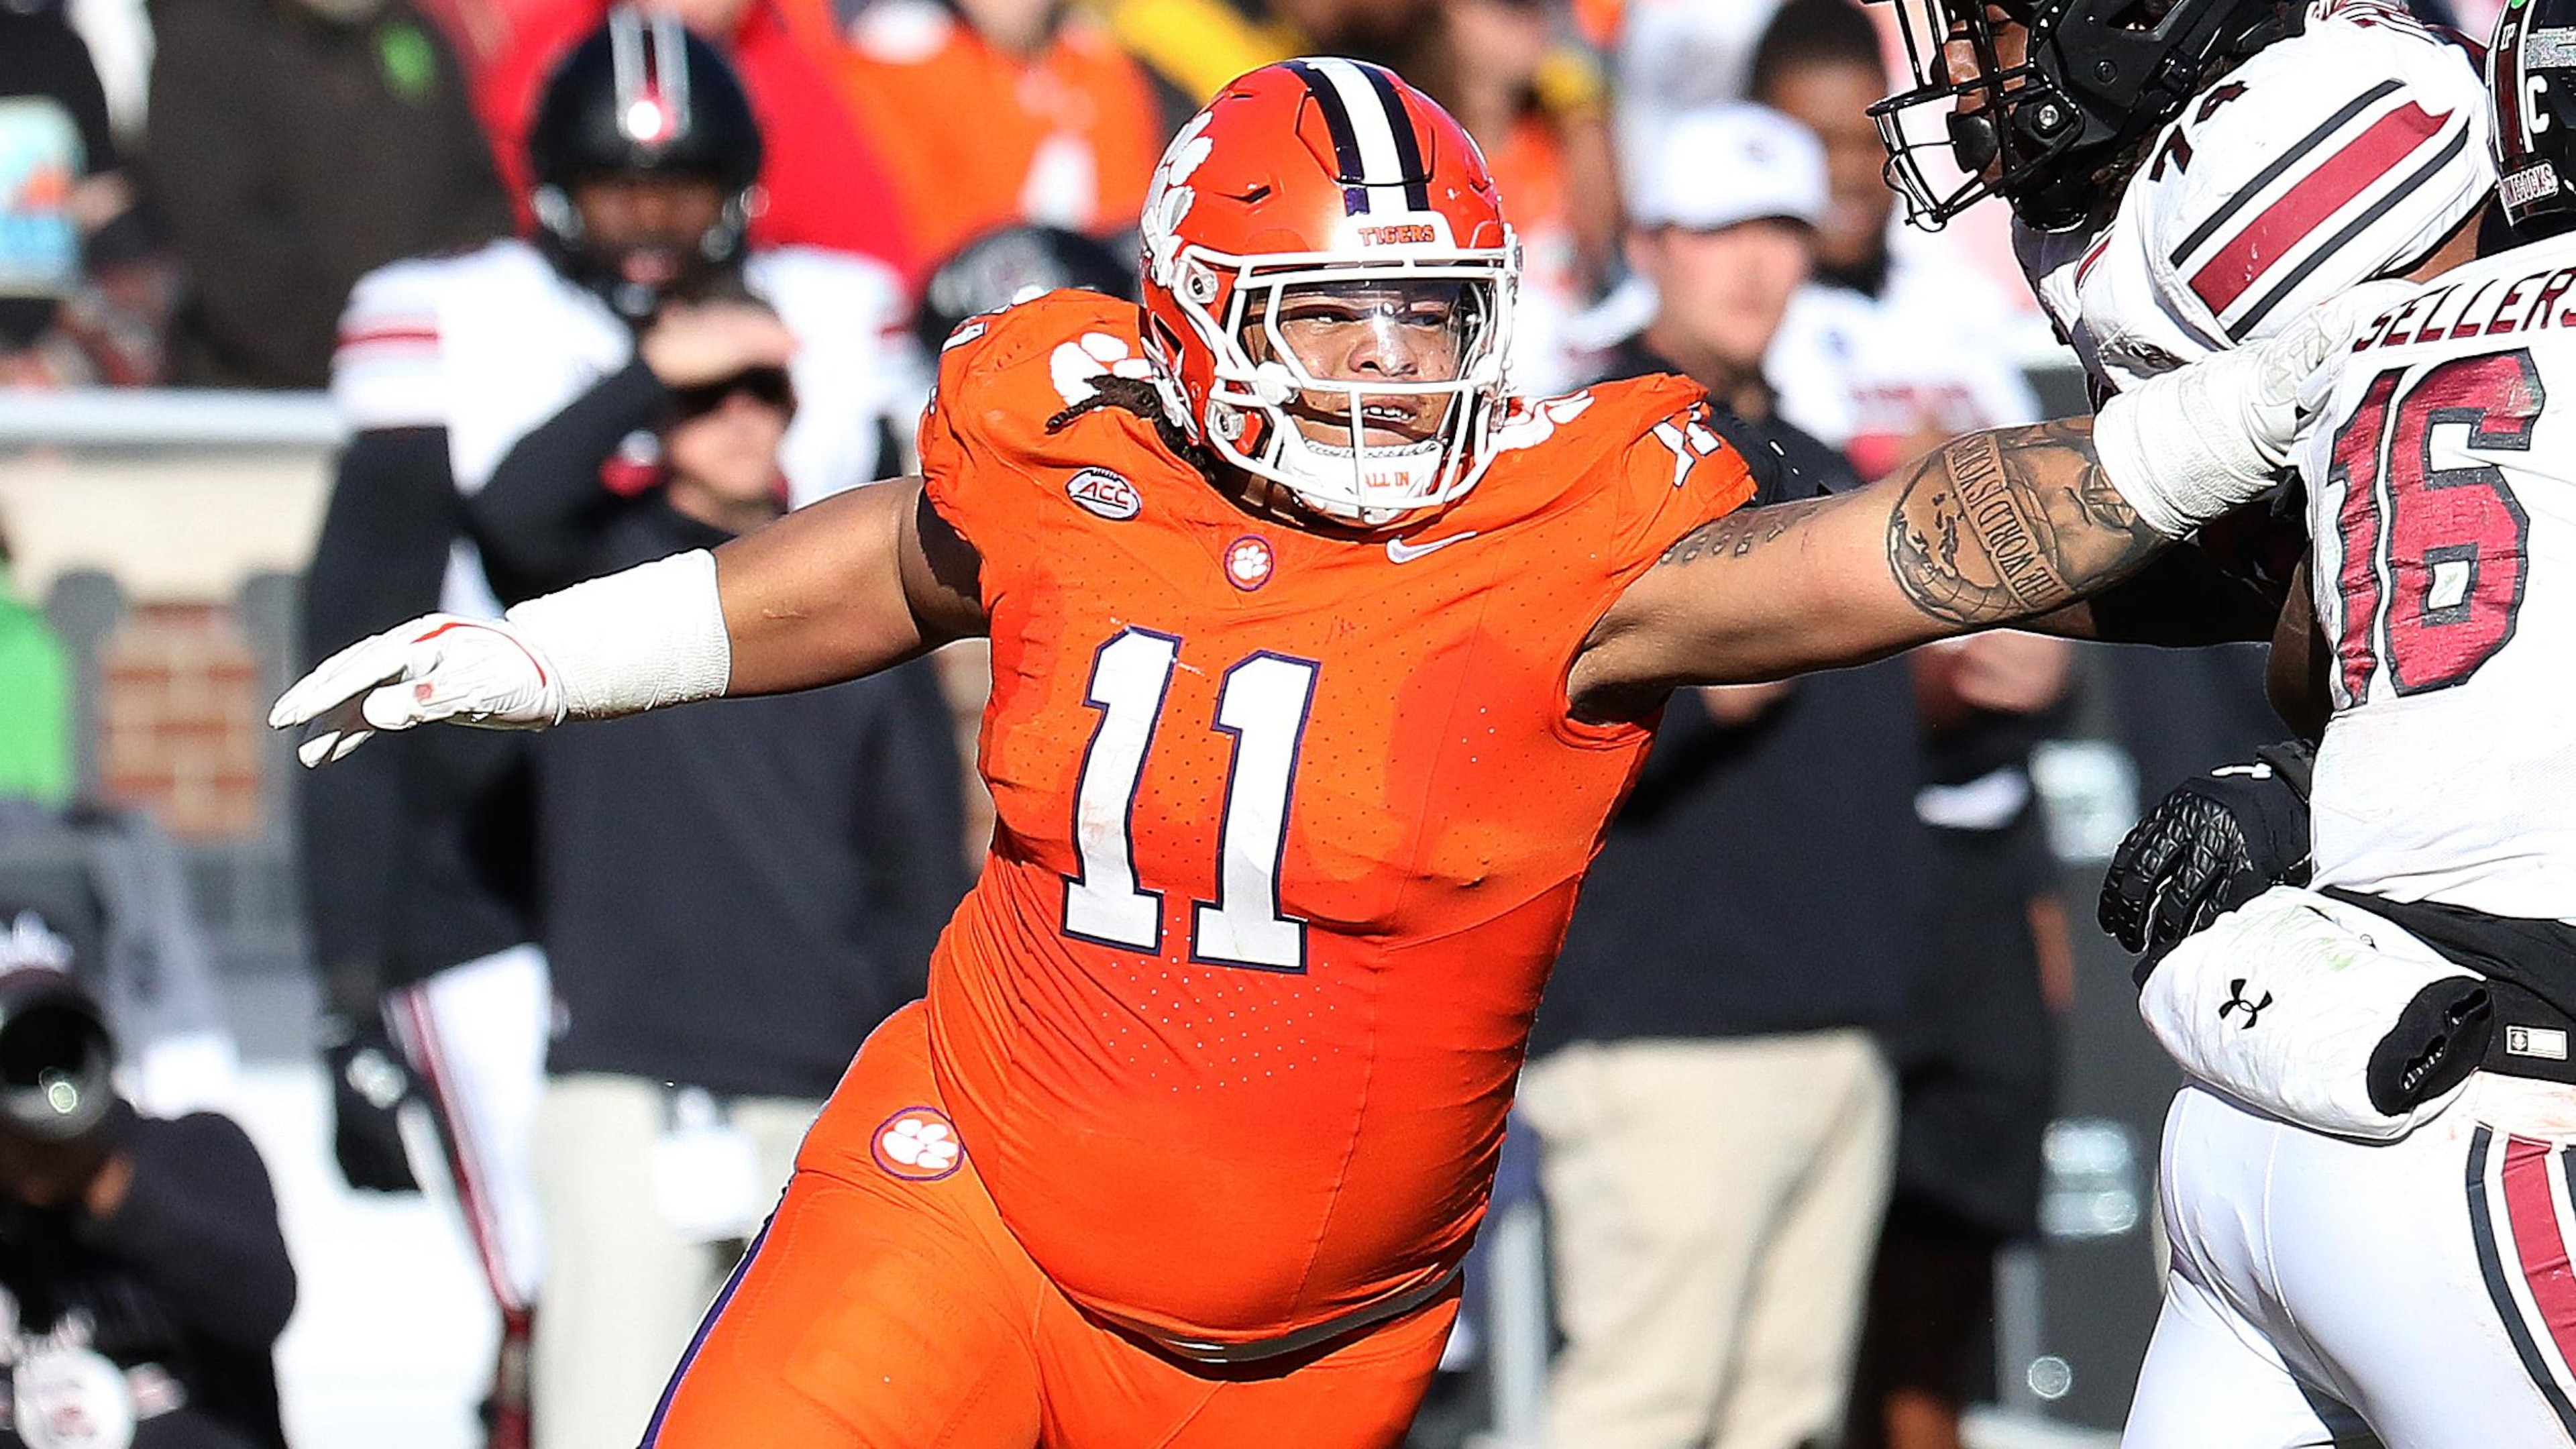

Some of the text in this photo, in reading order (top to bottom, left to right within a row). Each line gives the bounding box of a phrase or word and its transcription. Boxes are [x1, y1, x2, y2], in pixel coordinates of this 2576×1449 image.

[2526, 74, 2550, 133] C
[1358, 225, 1435, 247] TIGERS
[1078, 481, 1130, 505] ACC
[1395, 472, 1409, 486] IN
[1965, 480, 2004, 510] IS
[1978, 500, 2035, 580] WORLD
[2328, 347, 2546, 706] 16
[2012, 567, 2063, 608] THE
[1059, 624, 1322, 975] 11
